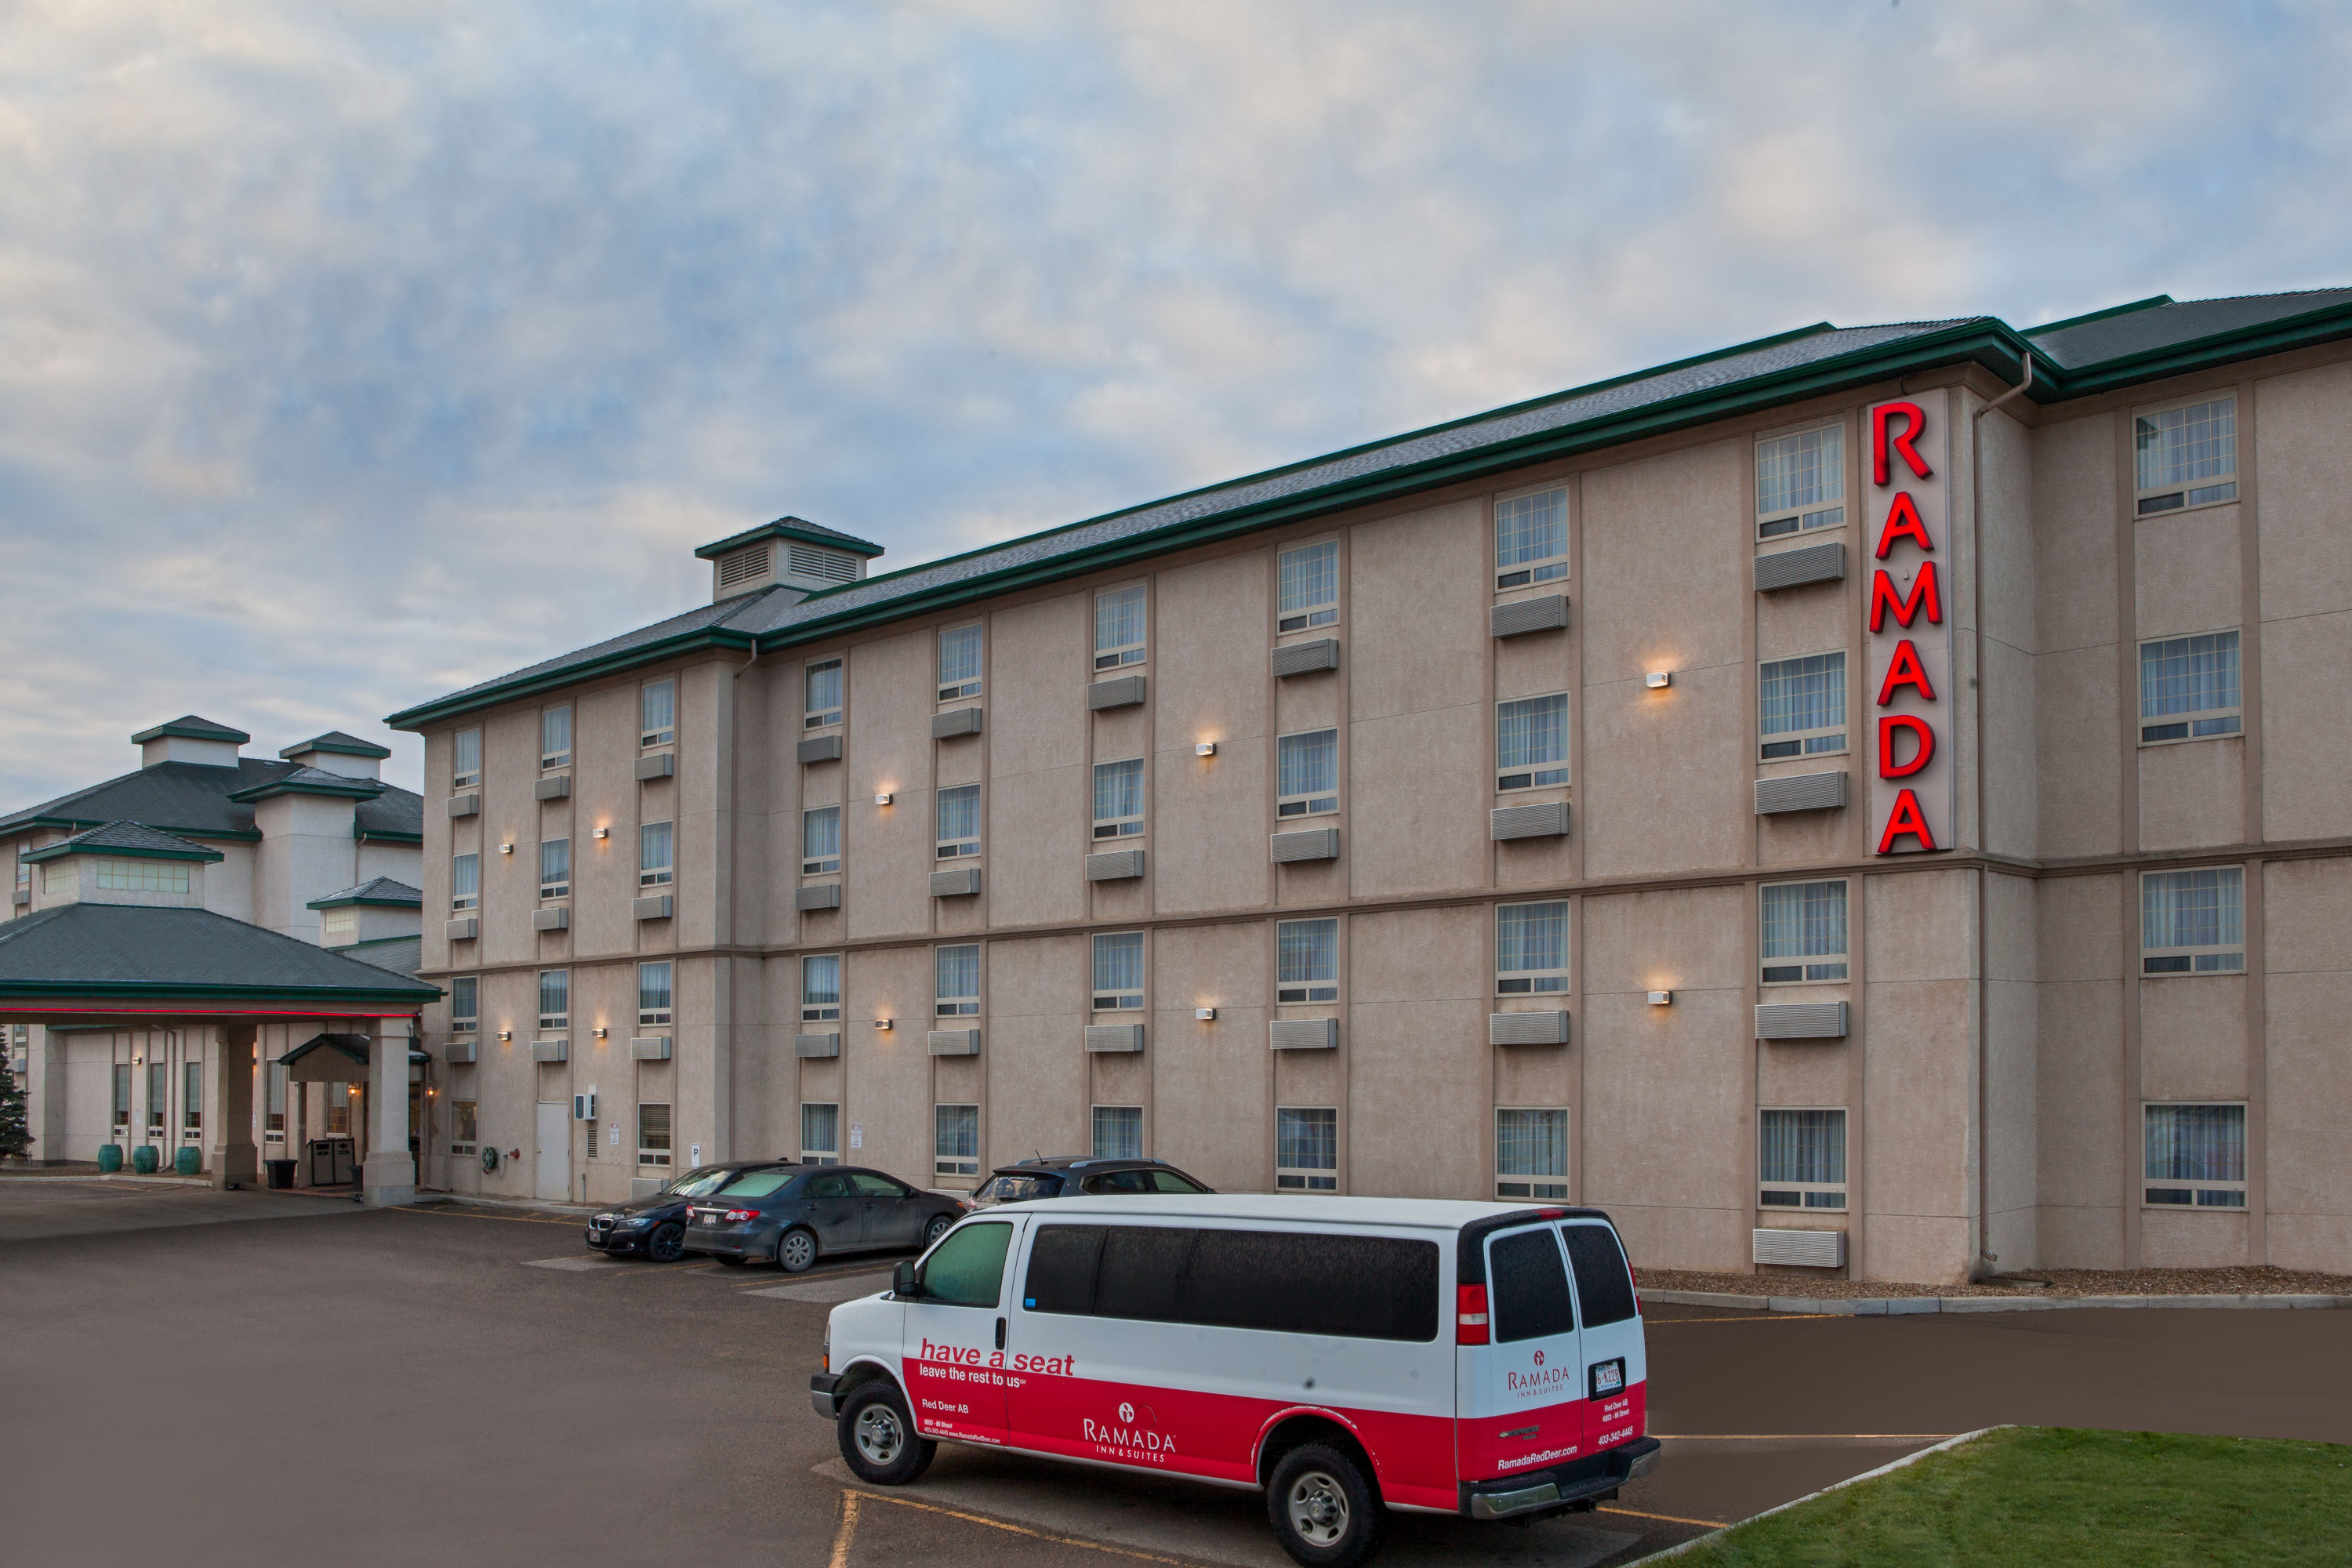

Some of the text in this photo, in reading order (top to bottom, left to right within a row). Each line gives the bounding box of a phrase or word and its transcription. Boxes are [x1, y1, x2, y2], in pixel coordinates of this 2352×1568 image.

[1869, 401, 1943, 854] RAMADA
[693, 1149, 699, 1157] P
[920, 1338, 1075, 1377] have a seat
[920, 1363, 946, 1379] leave
[949, 1367, 966, 1381] the
[968, 1371, 990, 1385] rest
[992, 1373, 1004, 1386] to
[1508, 1367, 1570, 1391] RAMADA
[1517, 1390, 1531, 1399] INN
[1539, 1384, 1563, 1395] SUITES
[922, 1398, 969, 1414] Red Deer AB
[1619, 1408, 1630, 1417] Street
[924, 1427, 1000, 1443] 403-342-4445 www.RamadaRedDeer.com
[1083, 1417, 1176, 1453] RAMADA
[1598, 1425, 1634, 1445] 403-342-4445
[1096, 1444, 1164, 1462] INN & SUITES
[1497, 1445, 1577, 1470] RamadaRedDeer.com
